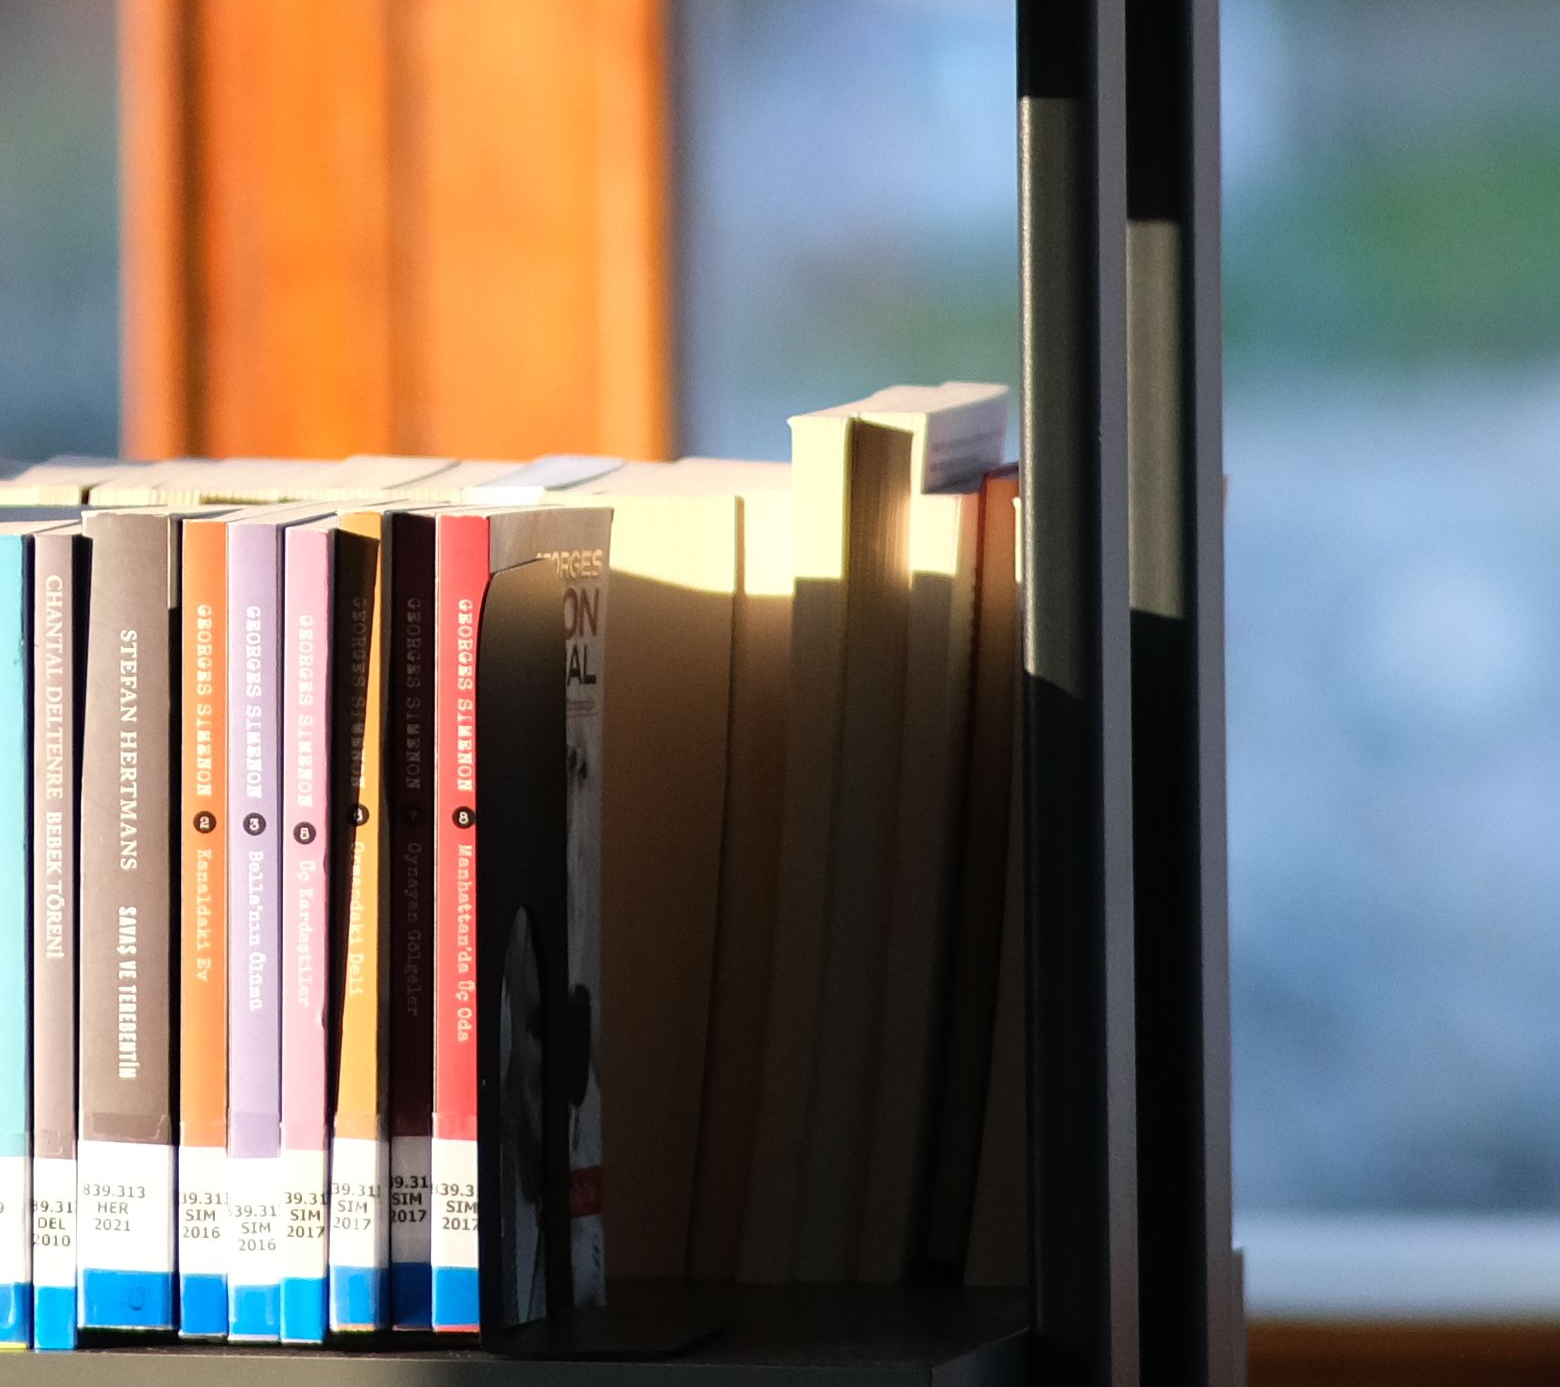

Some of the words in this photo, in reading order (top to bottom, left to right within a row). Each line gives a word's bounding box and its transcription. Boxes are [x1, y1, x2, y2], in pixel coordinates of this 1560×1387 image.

[43, 575, 65, 679] CHANTAL
[45, 687, 65, 799] DELTENRE
[44, 812, 65, 876] BEBEK
[46, 881, 66, 958] TÖRENİ
